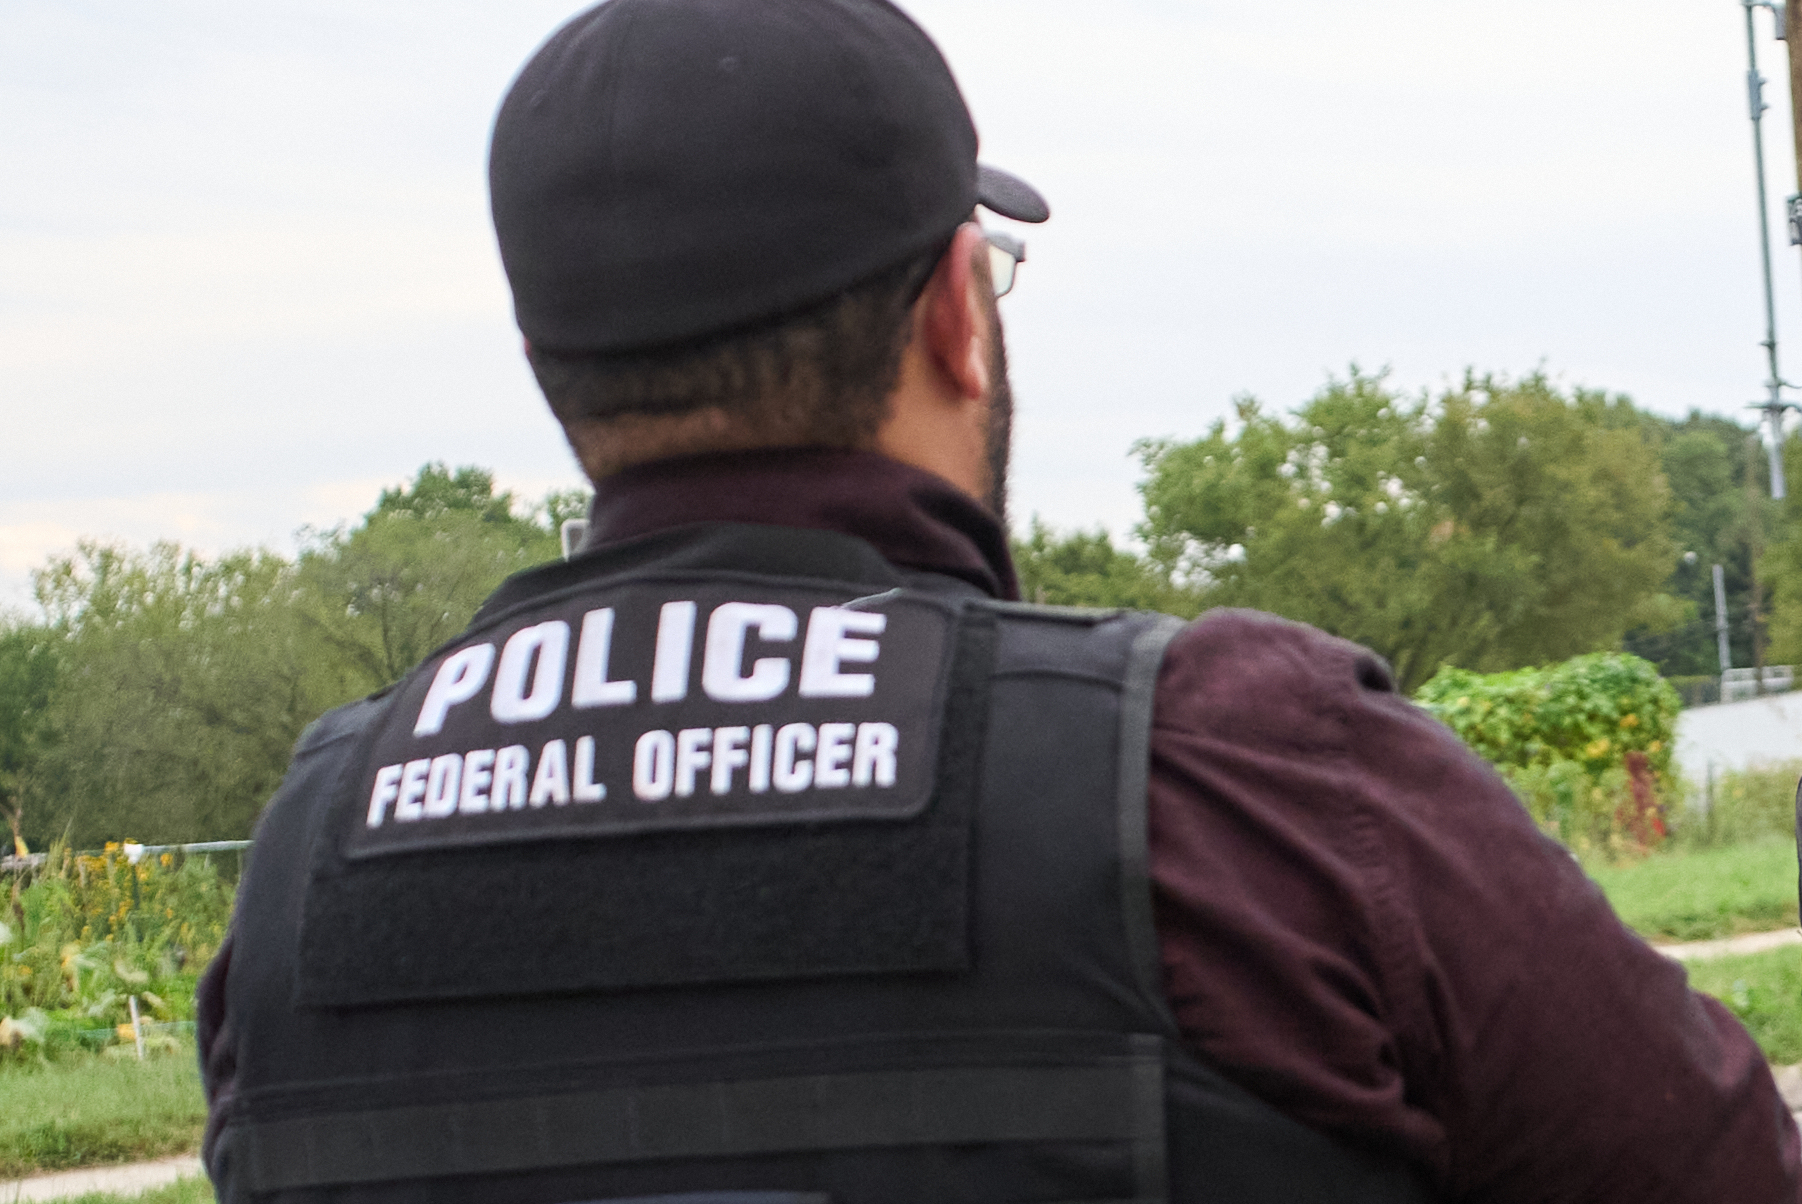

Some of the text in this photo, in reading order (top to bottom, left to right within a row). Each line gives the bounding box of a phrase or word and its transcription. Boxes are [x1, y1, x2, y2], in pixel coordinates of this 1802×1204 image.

[413, 601, 887, 737] POLICE
[367, 722, 898, 828] FEDERAL OFFICER
